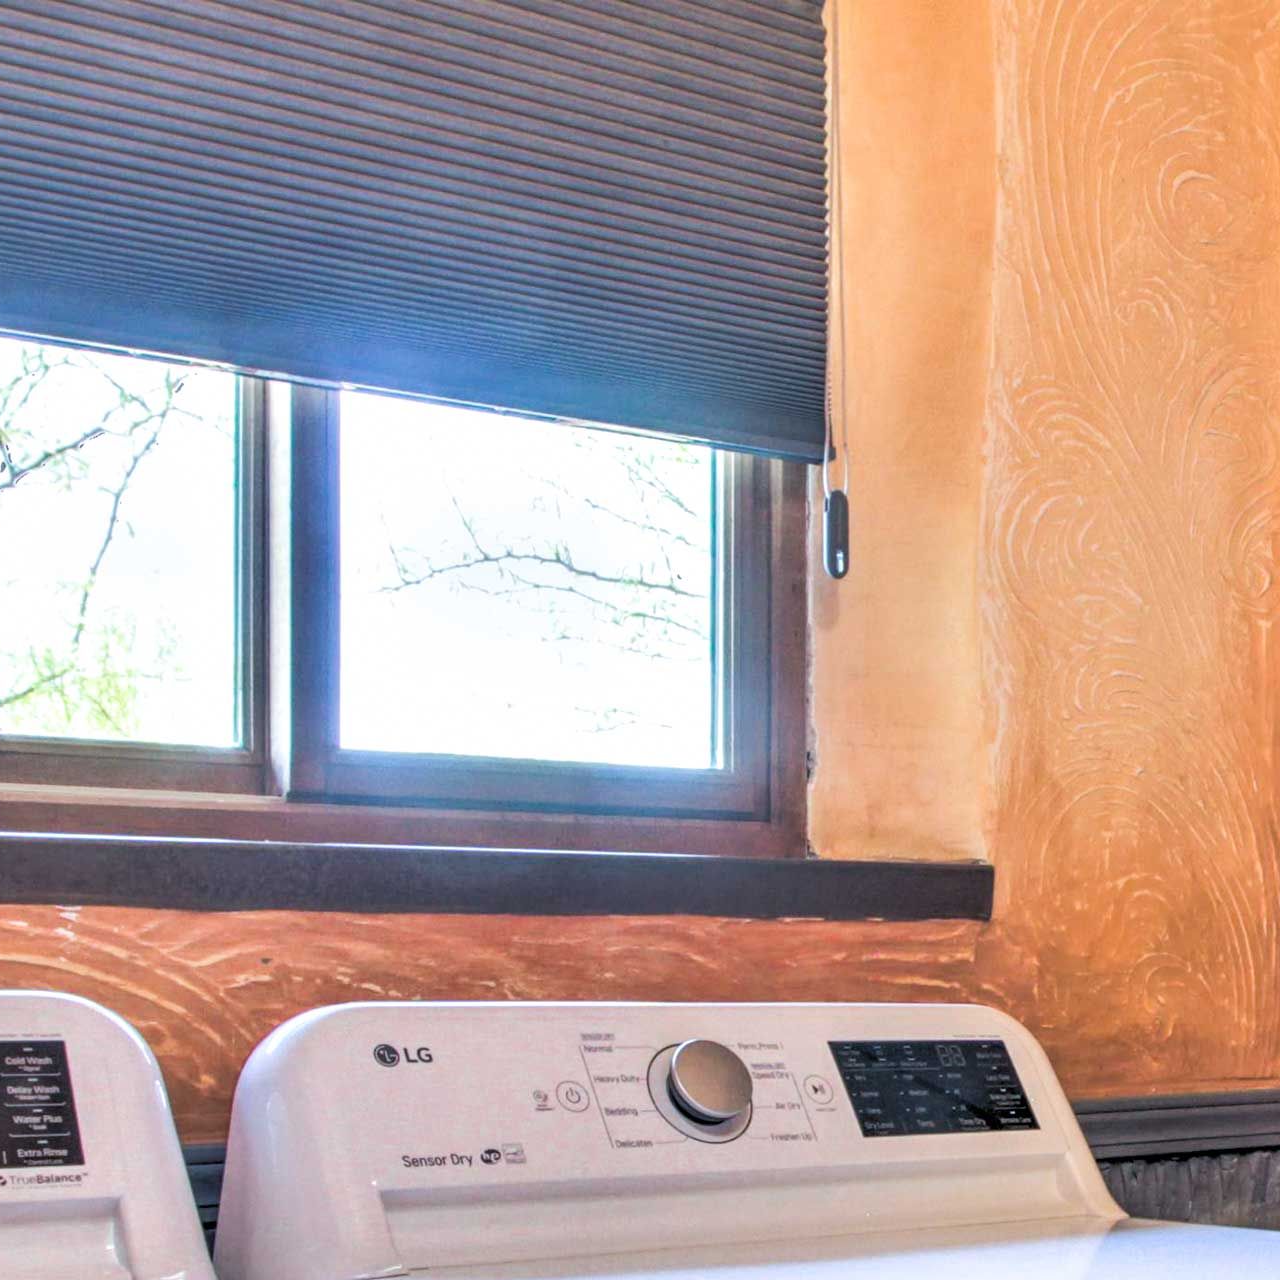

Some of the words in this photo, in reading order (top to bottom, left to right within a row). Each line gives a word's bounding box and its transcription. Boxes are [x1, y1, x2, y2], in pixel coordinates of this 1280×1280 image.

[5, 1057, 26, 1065] Cold
[27, 1056, 53, 1065] Wash
[404, 1047, 434, 1064] LG
[593, 1074, 620, 1085] Heavy
[6, 1085, 32, 1096] Delay
[33, 1085, 60, 1094] Wash
[604, 1107, 638, 1117] Bedding
[12, 1115, 42, 1124] Water
[43, 1114, 63, 1124] Plus
[615, 1139, 653, 1149] Delicates
[17, 1149, 42, 1158] Extra
[402, 1154, 447, 1169] Sensor
[450, 1153, 473, 1167] Dry
